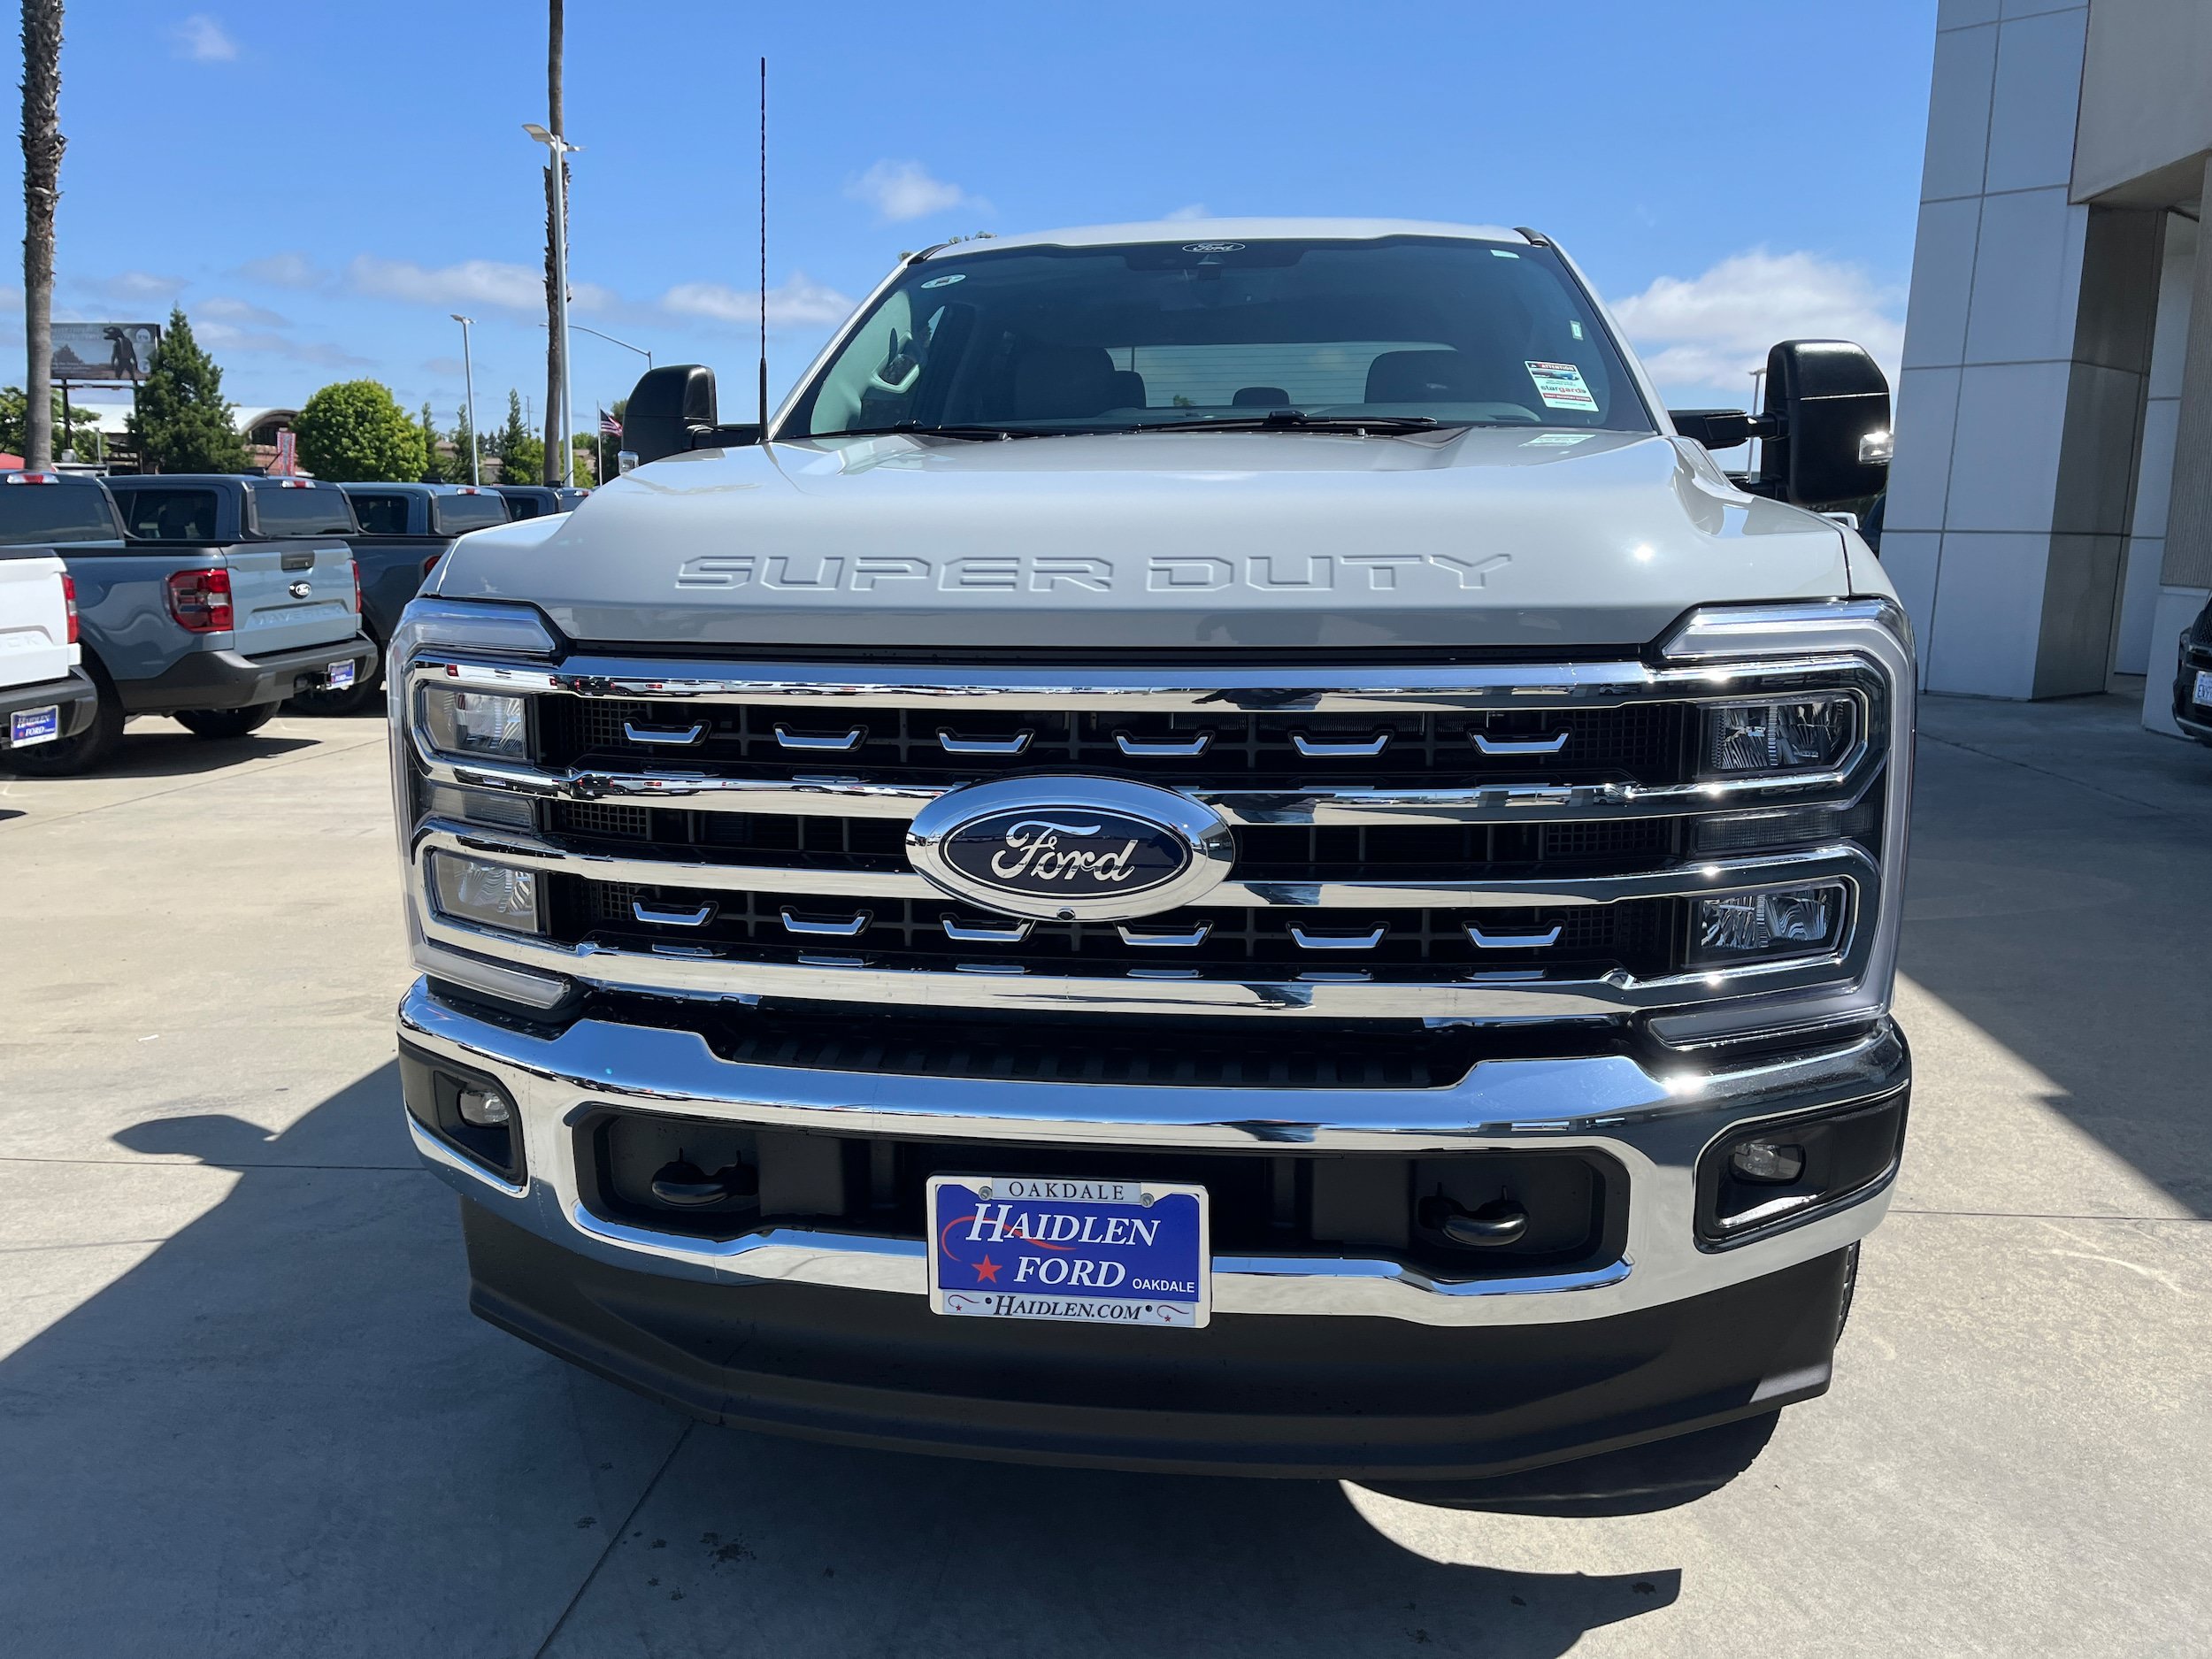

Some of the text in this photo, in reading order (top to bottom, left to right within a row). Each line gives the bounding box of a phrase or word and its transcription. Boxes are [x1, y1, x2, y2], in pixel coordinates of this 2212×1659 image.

[1193, 242, 1234, 251] Ford
[675, 554, 1512, 592] SUPER DUTY
[991, 820, 1138, 881] Ford
[1009, 1180, 1125, 1201] OAKDALE
[965, 1202, 1161, 1247] HAIDLEN
[1013, 1256, 1126, 1288] FORD
[1132, 1278, 1195, 1294] OAKDALE
[993, 1294, 1143, 1321] HAIDLEN.COM
